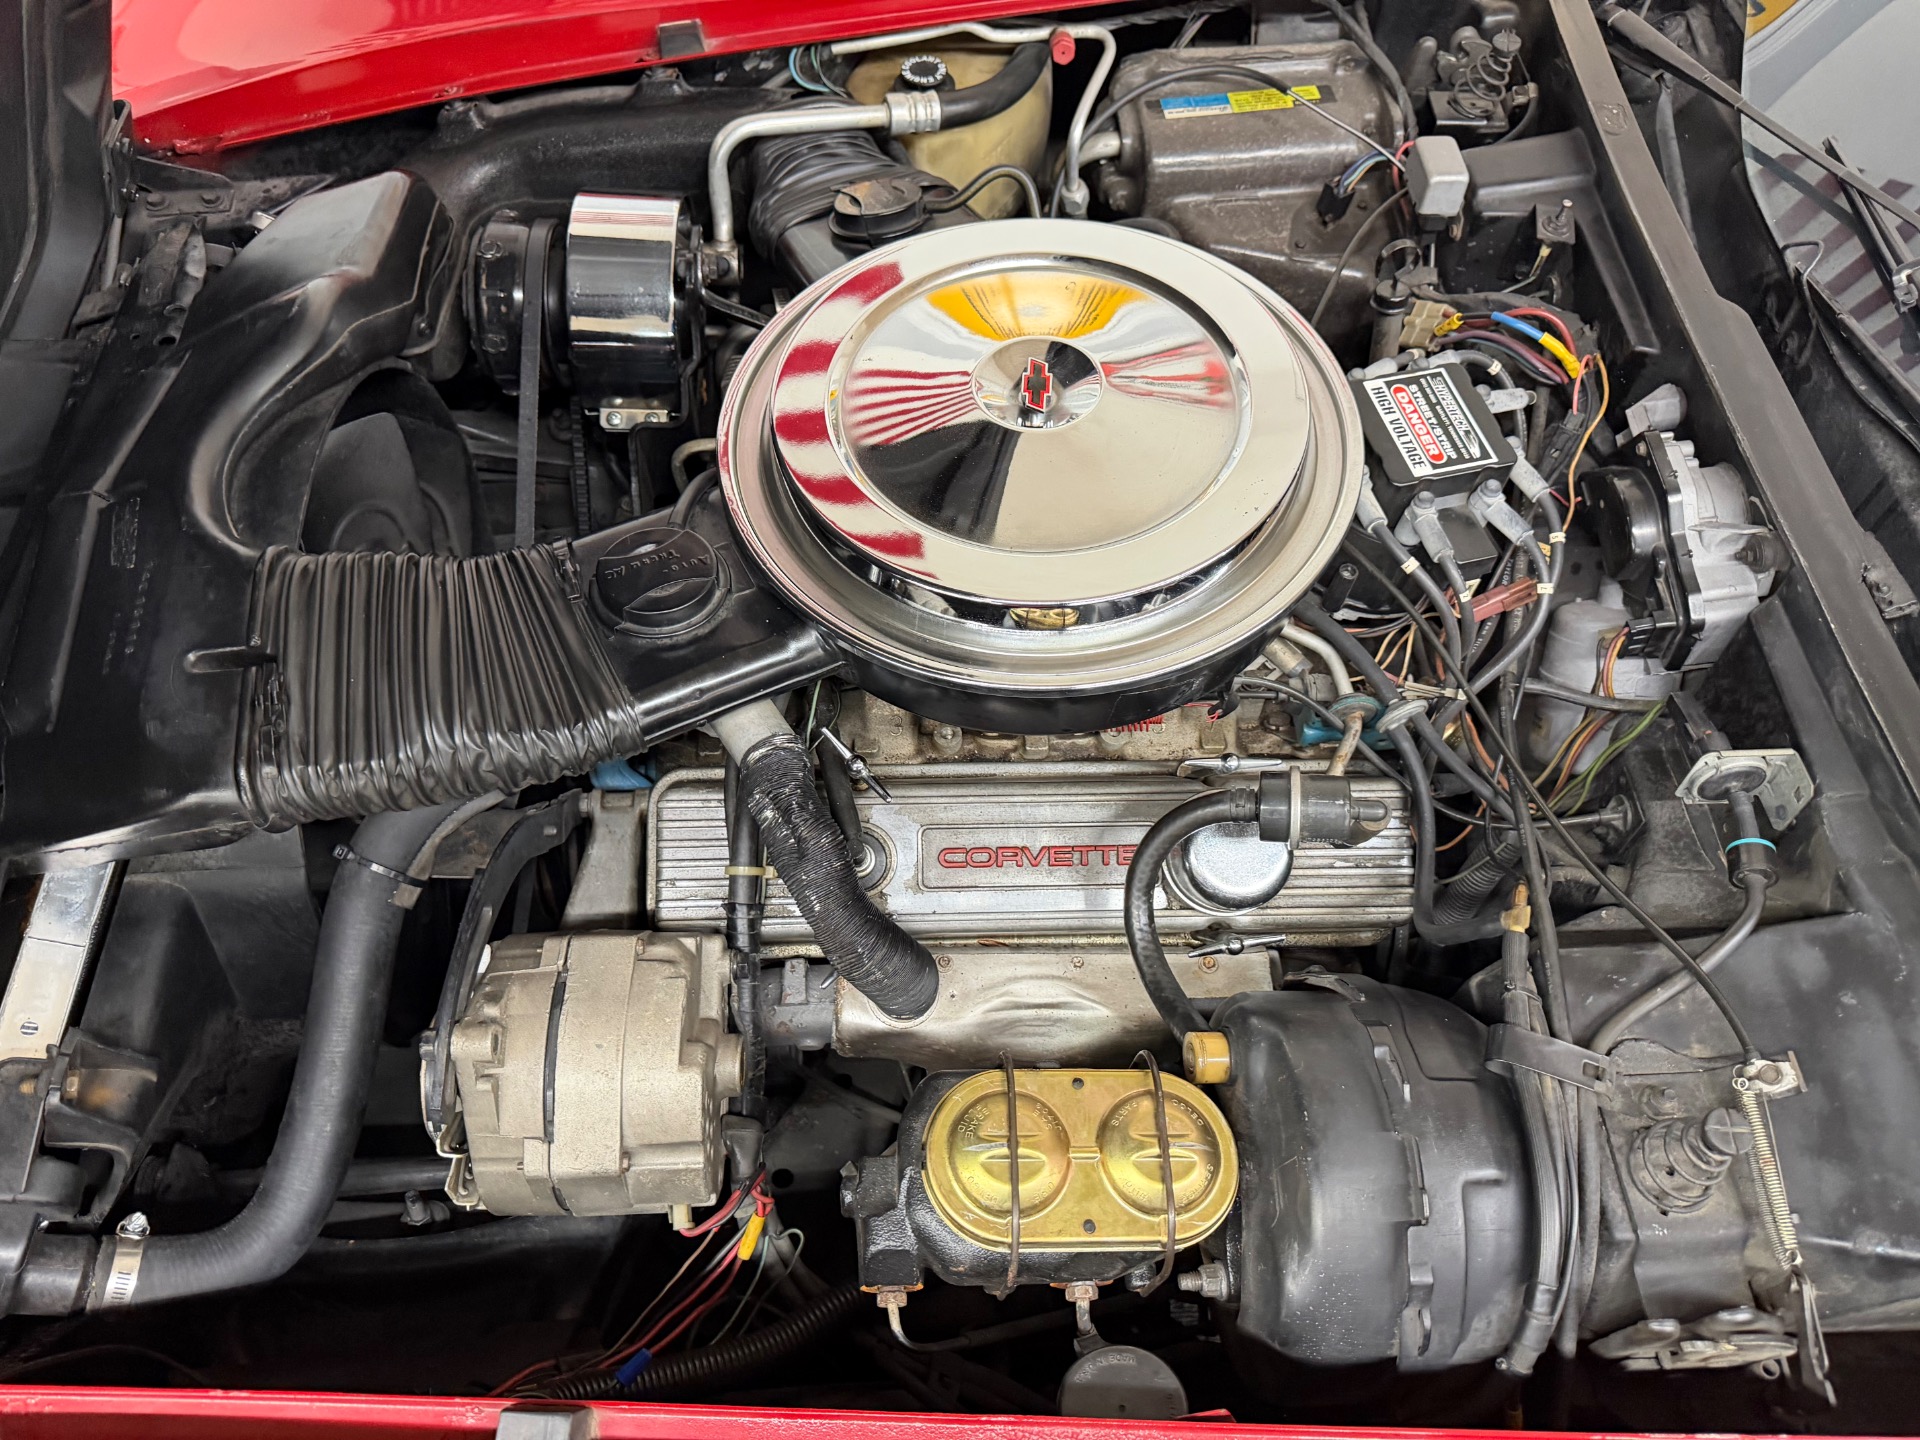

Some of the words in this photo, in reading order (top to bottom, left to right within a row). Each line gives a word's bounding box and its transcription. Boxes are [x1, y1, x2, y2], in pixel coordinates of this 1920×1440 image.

[1409, 384, 1458, 459] STREET/STRIP
[1434, 385, 1470, 431] HYPERTECH
[1371, 386, 1396, 416] HIGH
[1388, 417, 1428, 470] VOLTAGE
[1396, 391, 1441, 456] DANGER
[1502, 559, 1514, 585] TAYLOR
[938, 844, 1138, 868] CORVETTE
[957, 1104, 982, 1133] FLUID
[965, 1107, 990, 1139] BRAKE
[1032, 1110, 1052, 1130] SAE
[1111, 1101, 1138, 1127] PARTS
[1171, 1099, 1204, 1126] DELCO
